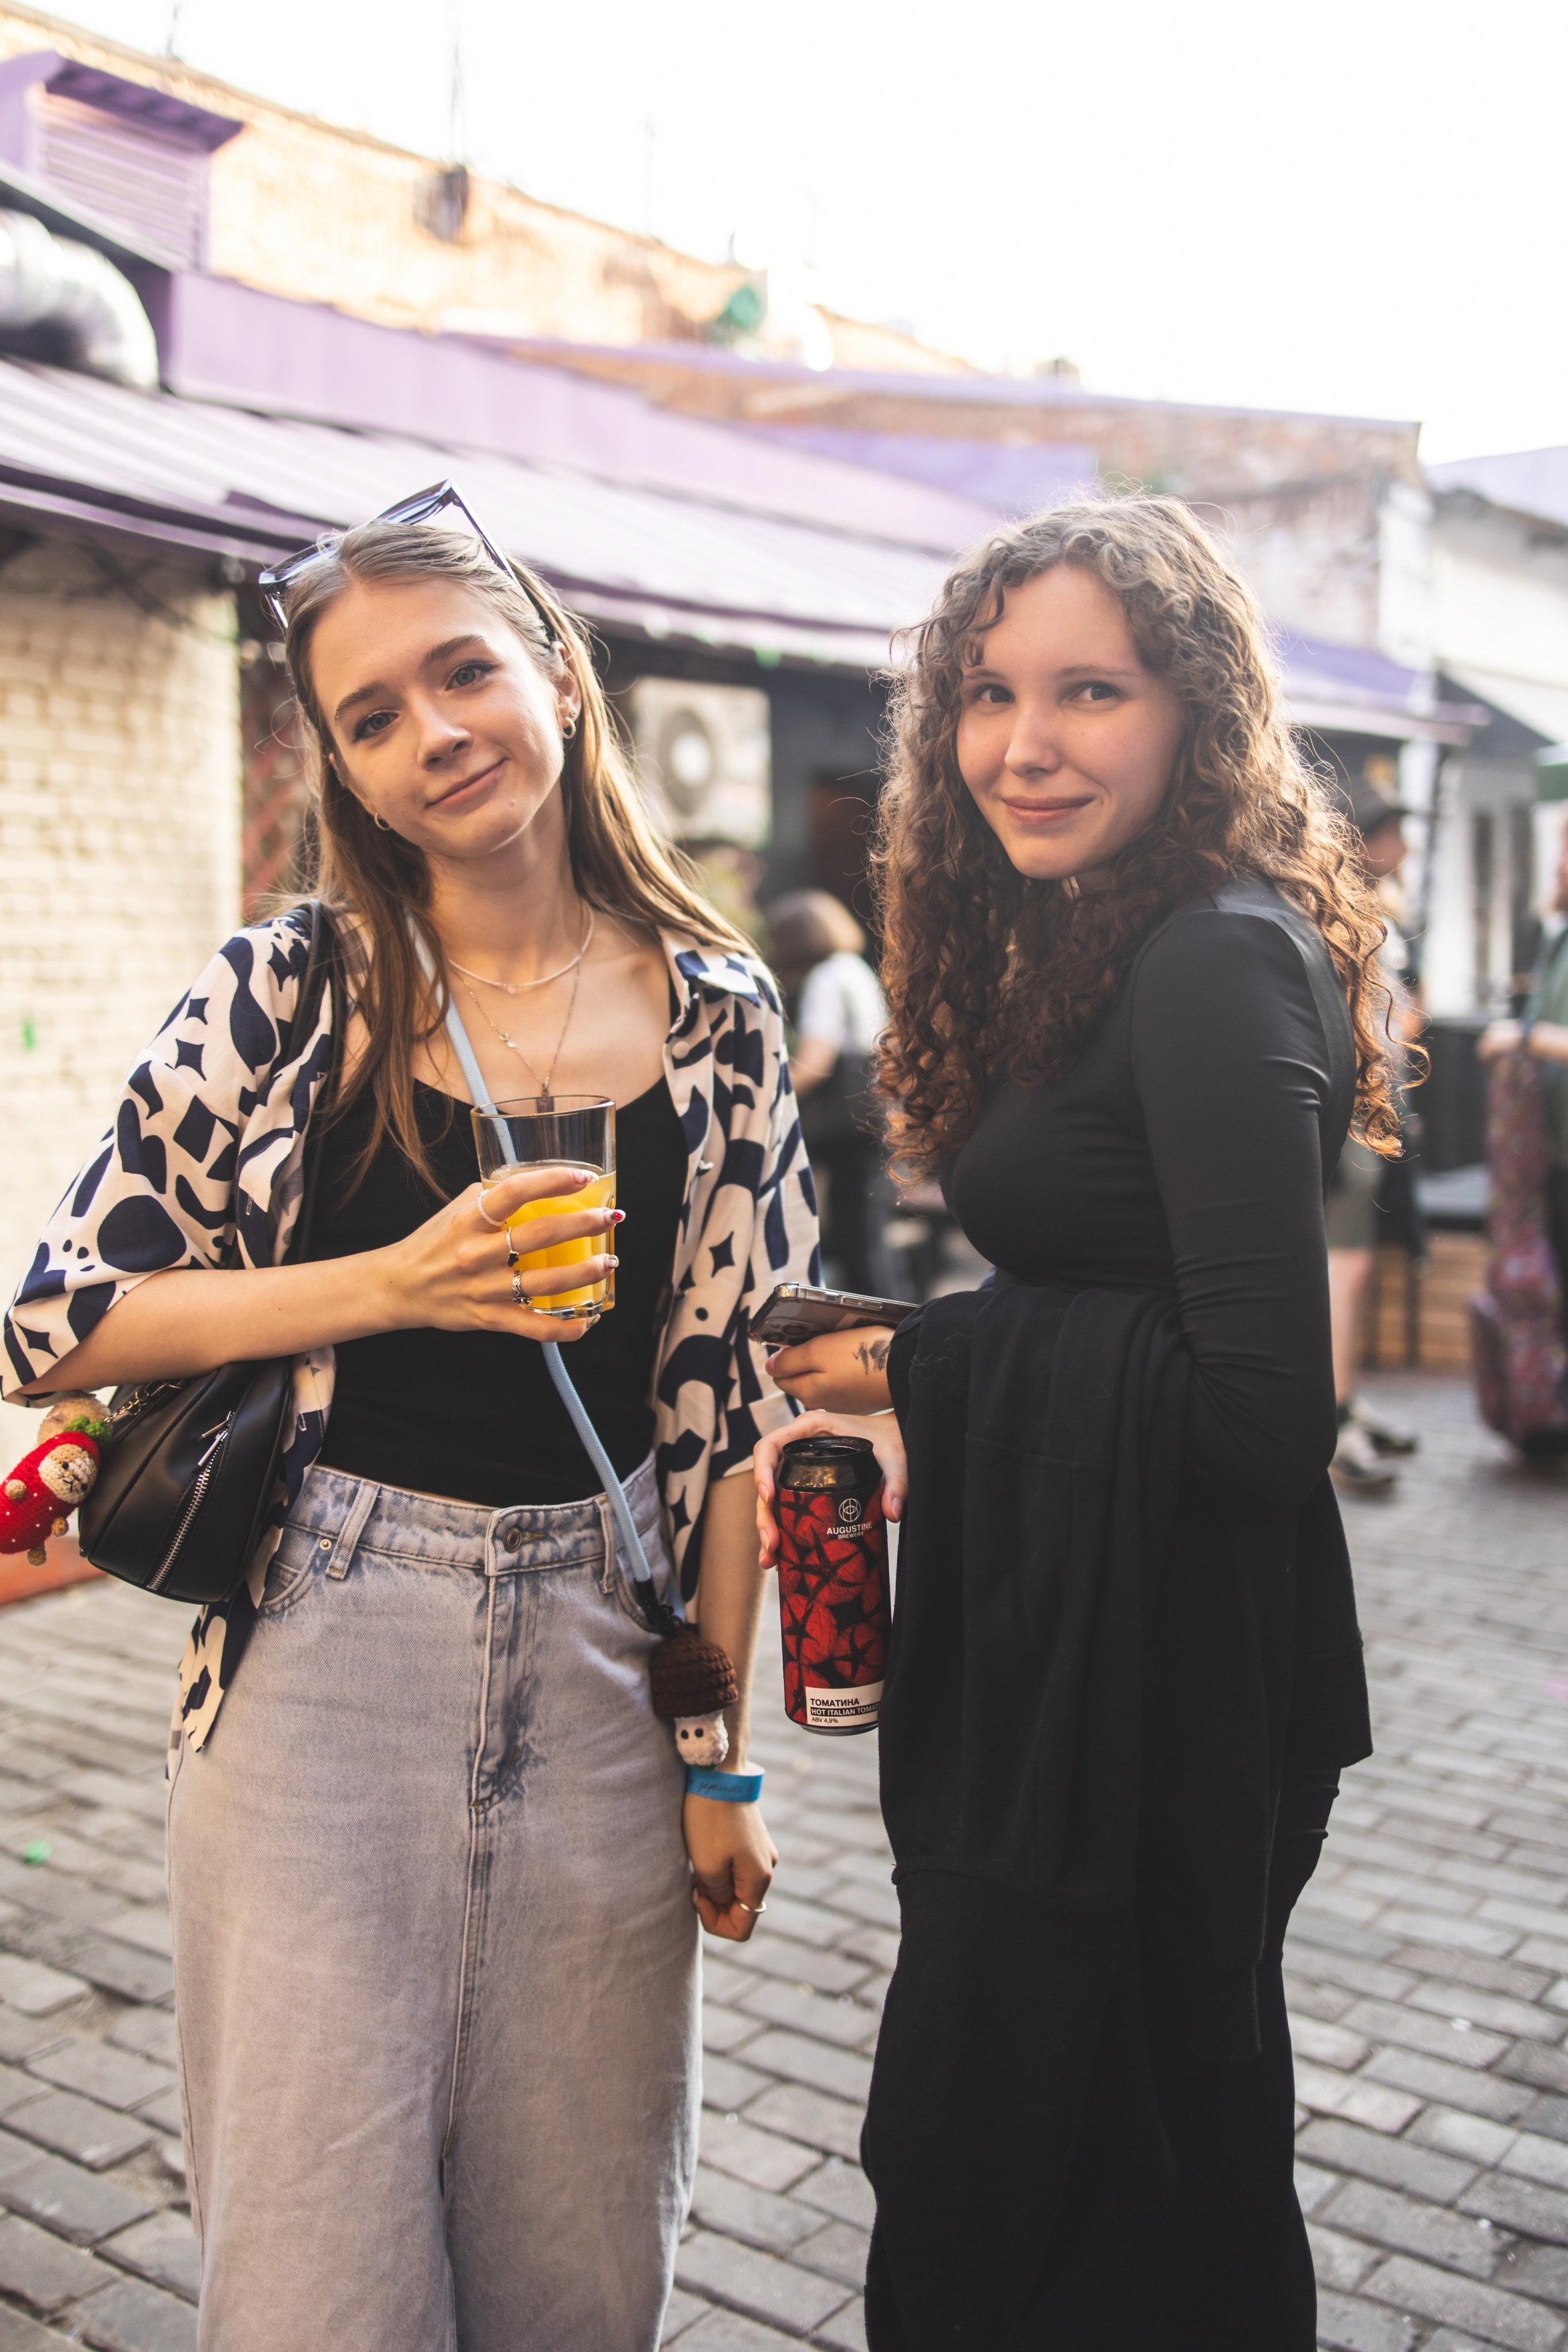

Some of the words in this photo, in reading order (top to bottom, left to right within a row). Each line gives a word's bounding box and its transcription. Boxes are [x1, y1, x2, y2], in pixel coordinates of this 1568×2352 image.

[827, 1521, 872, 1535] AUGUSTINE
[810, 1698, 859, 1706] ТОМАТИНА
[857, 1703, 880, 1714] TOMAT
